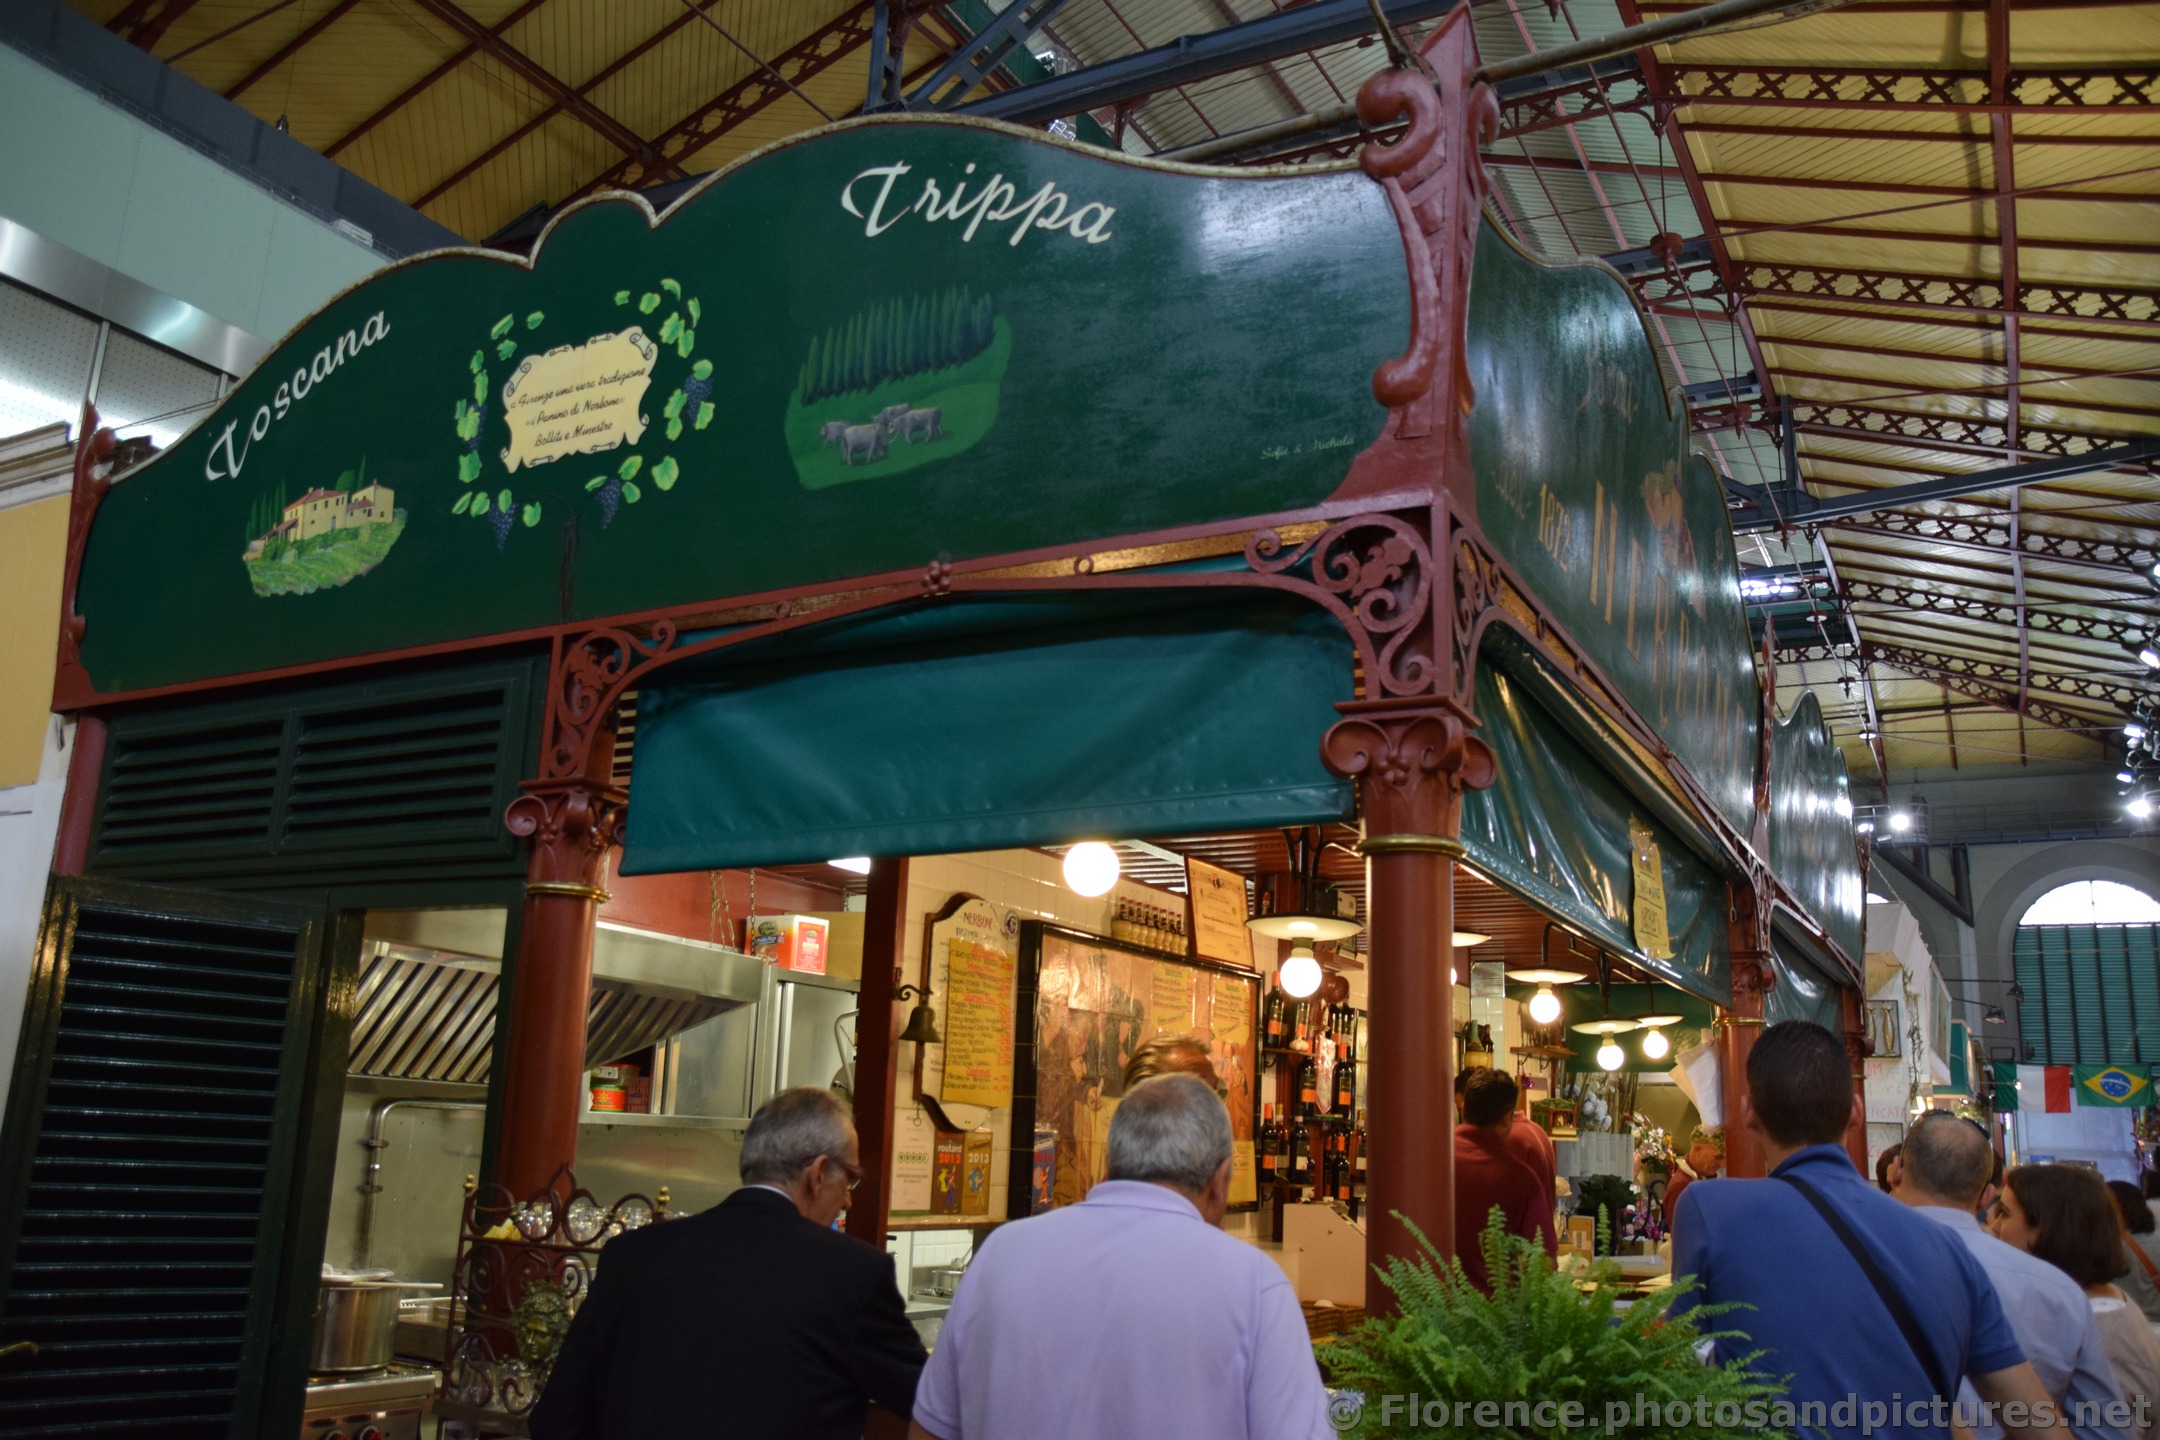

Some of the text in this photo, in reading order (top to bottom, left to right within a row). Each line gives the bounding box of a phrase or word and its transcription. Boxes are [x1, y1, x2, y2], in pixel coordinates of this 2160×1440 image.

[841, 160, 1116, 247] Trippa
[205, 310, 391, 481] Toscana
[518, 391, 554, 408] Firenze
[555, 386, 574, 398] una
[598, 367, 646, 387] tradizione
[536, 410, 568, 425] Panino
[570, 403, 580, 416] di
[534, 431, 563, 448] Bolliti
[572, 419, 614, 439] Minestre
[1538, 482, 1571, 573] 1872
[938, 1144, 963, 1153] routard
[938, 1153, 961, 1165] 2012
[968, 1152, 990, 1164] 2013
